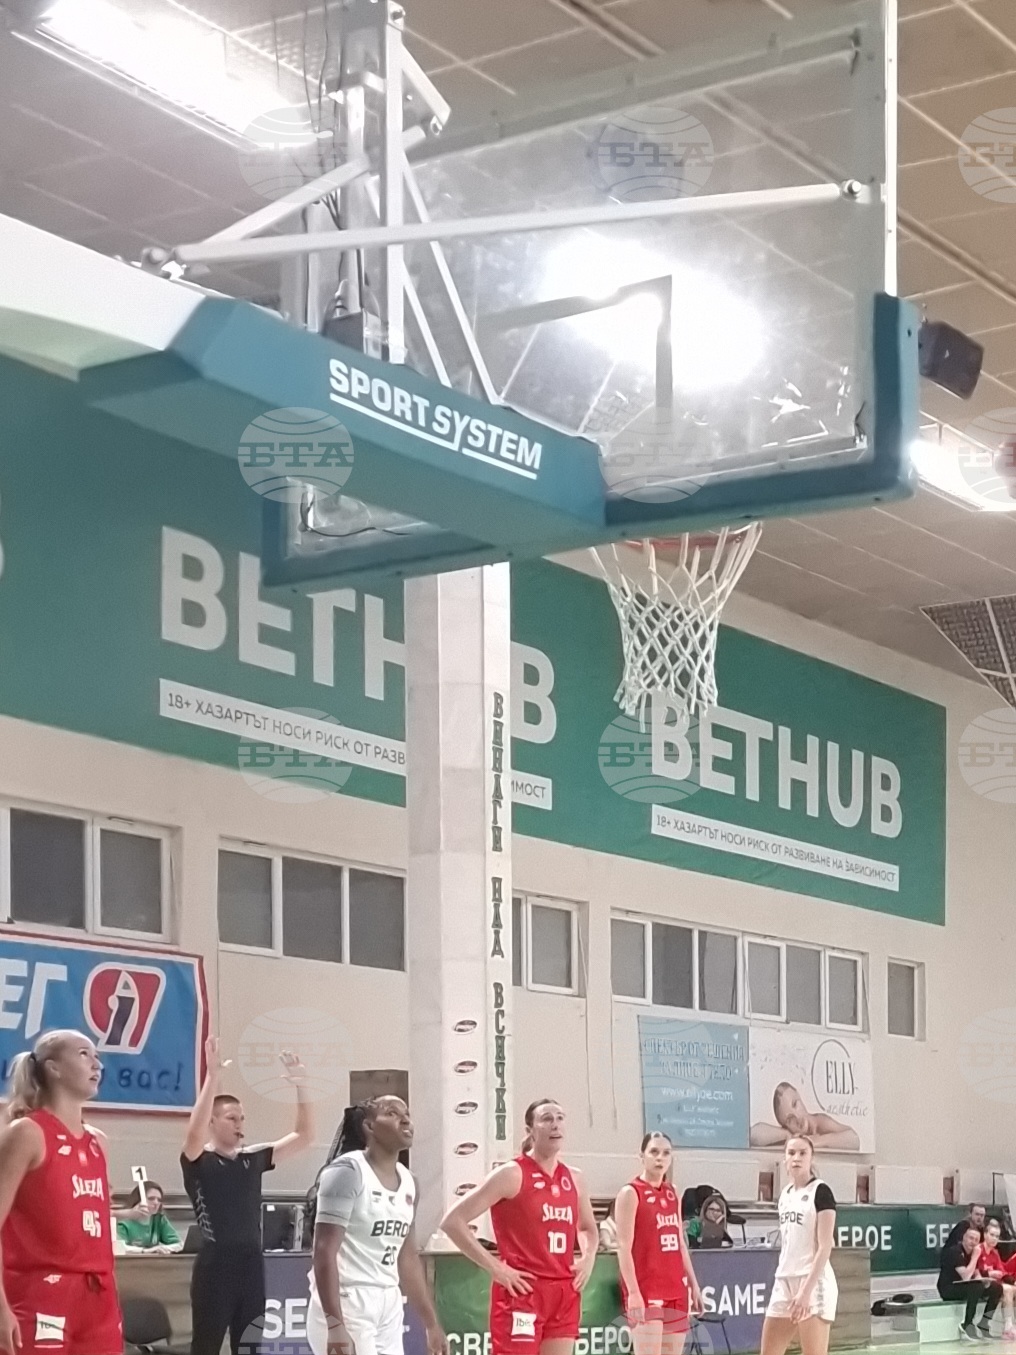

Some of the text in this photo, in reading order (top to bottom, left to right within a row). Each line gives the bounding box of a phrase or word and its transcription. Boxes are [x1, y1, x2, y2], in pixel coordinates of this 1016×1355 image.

[329, 358, 543, 470] SPORT SYSTEM
[161, 525, 557, 744] BETHB
[168, 693, 406, 765] 18+ ХАЗАРТЪТ НОСИ РИСК ОТ РАЗВ
[652, 688, 903, 839] BETHUB
[511, 780, 546, 798] ИМОСТ
[656, 814, 671, 828] 18+
[673, 819, 718, 840] ХАЗАРТЪТ
[721, 830, 746, 847] НОСИ
[748, 836, 770, 852] РИСК
[772, 843, 782, 856] ОТ
[784, 844, 831, 868] РАЗВИВАНЕ
[833, 859, 843, 871] НА
[0, 957, 68, 1040] ЕГ
[826, 1060, 856, 1095] ELLY
[134, 1166, 144, 1181] 1
[370, 1220, 410, 1237] BERO
[779, 1211, 804, 1225] EROE
[547, 1231, 567, 1254] 10
[660, 1234, 679, 1252] 99
[837, 1225, 893, 1251] ЕРОЕ
[688, 1283, 767, 1316] SAME
[575, 1325, 634, 1355] БЕРО
